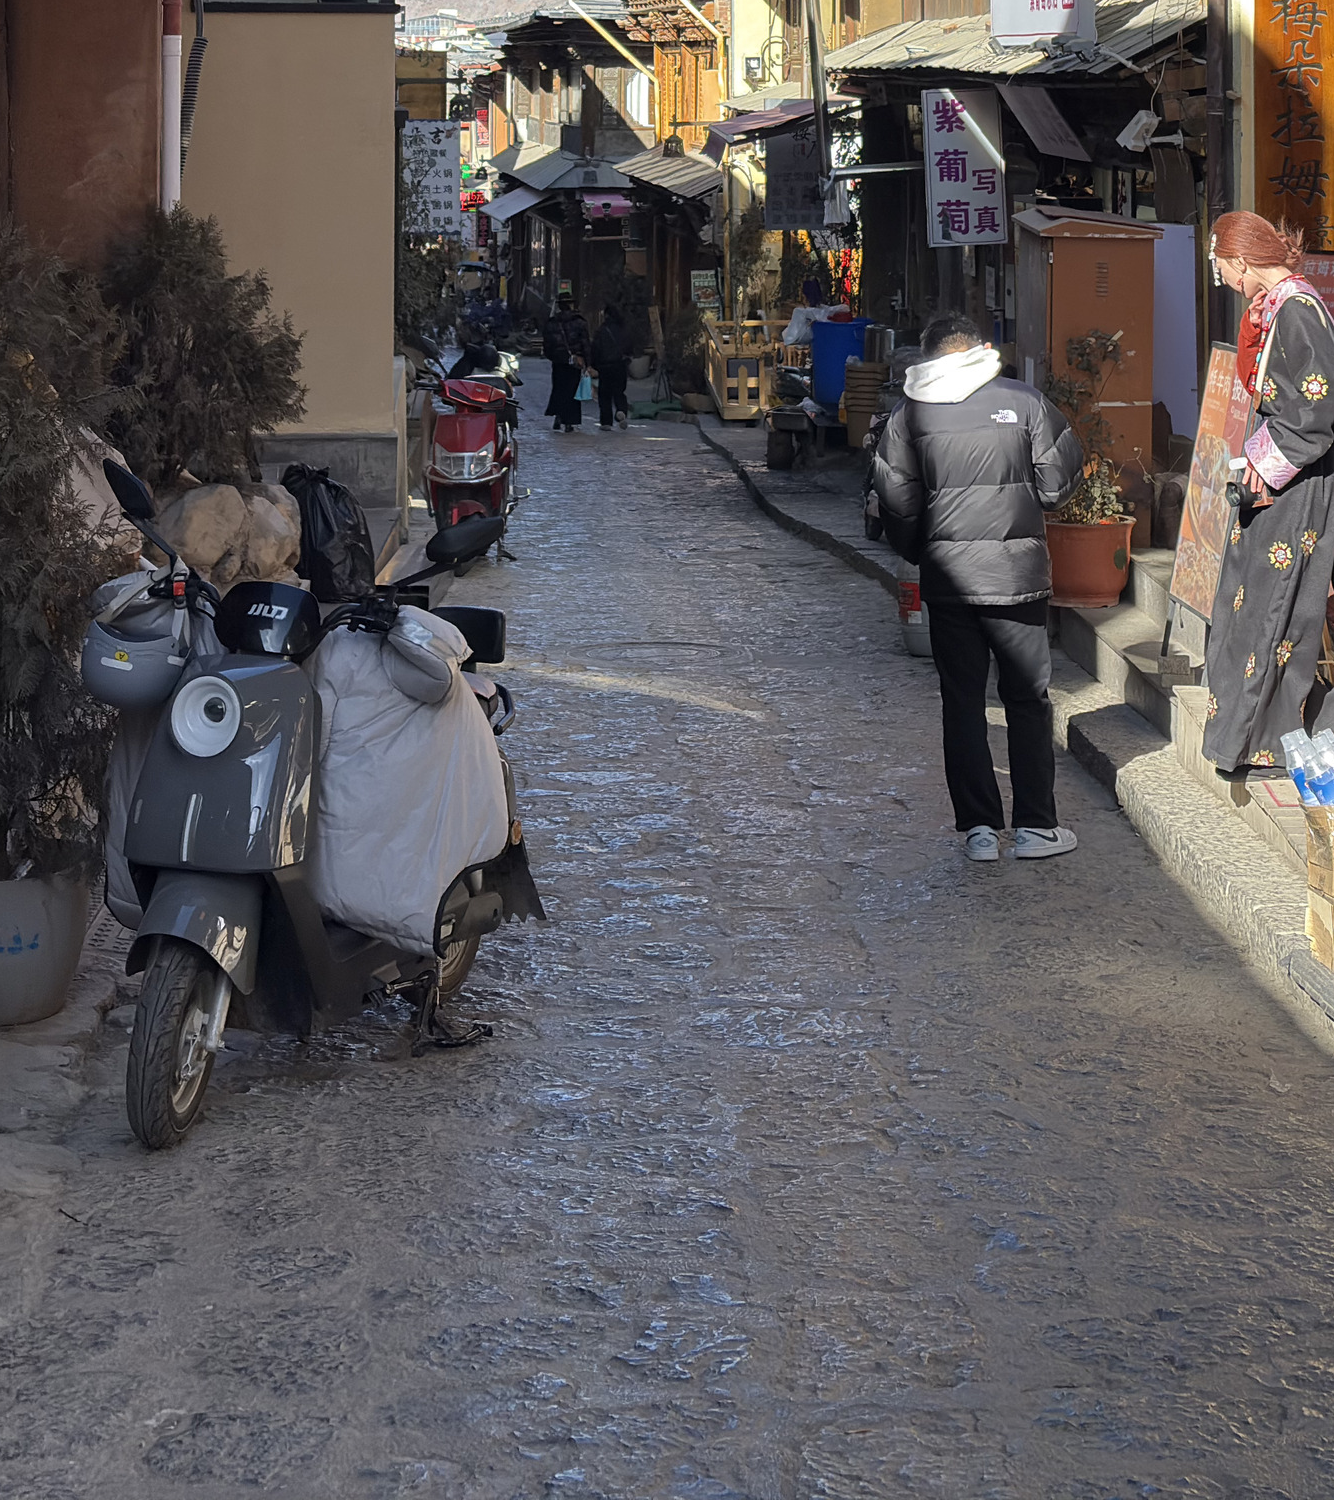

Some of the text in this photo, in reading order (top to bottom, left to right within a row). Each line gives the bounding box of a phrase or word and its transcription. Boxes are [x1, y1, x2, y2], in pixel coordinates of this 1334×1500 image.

[932, 98, 971, 236] 紫葡萄
[971, 168, 1000, 235] 写真
